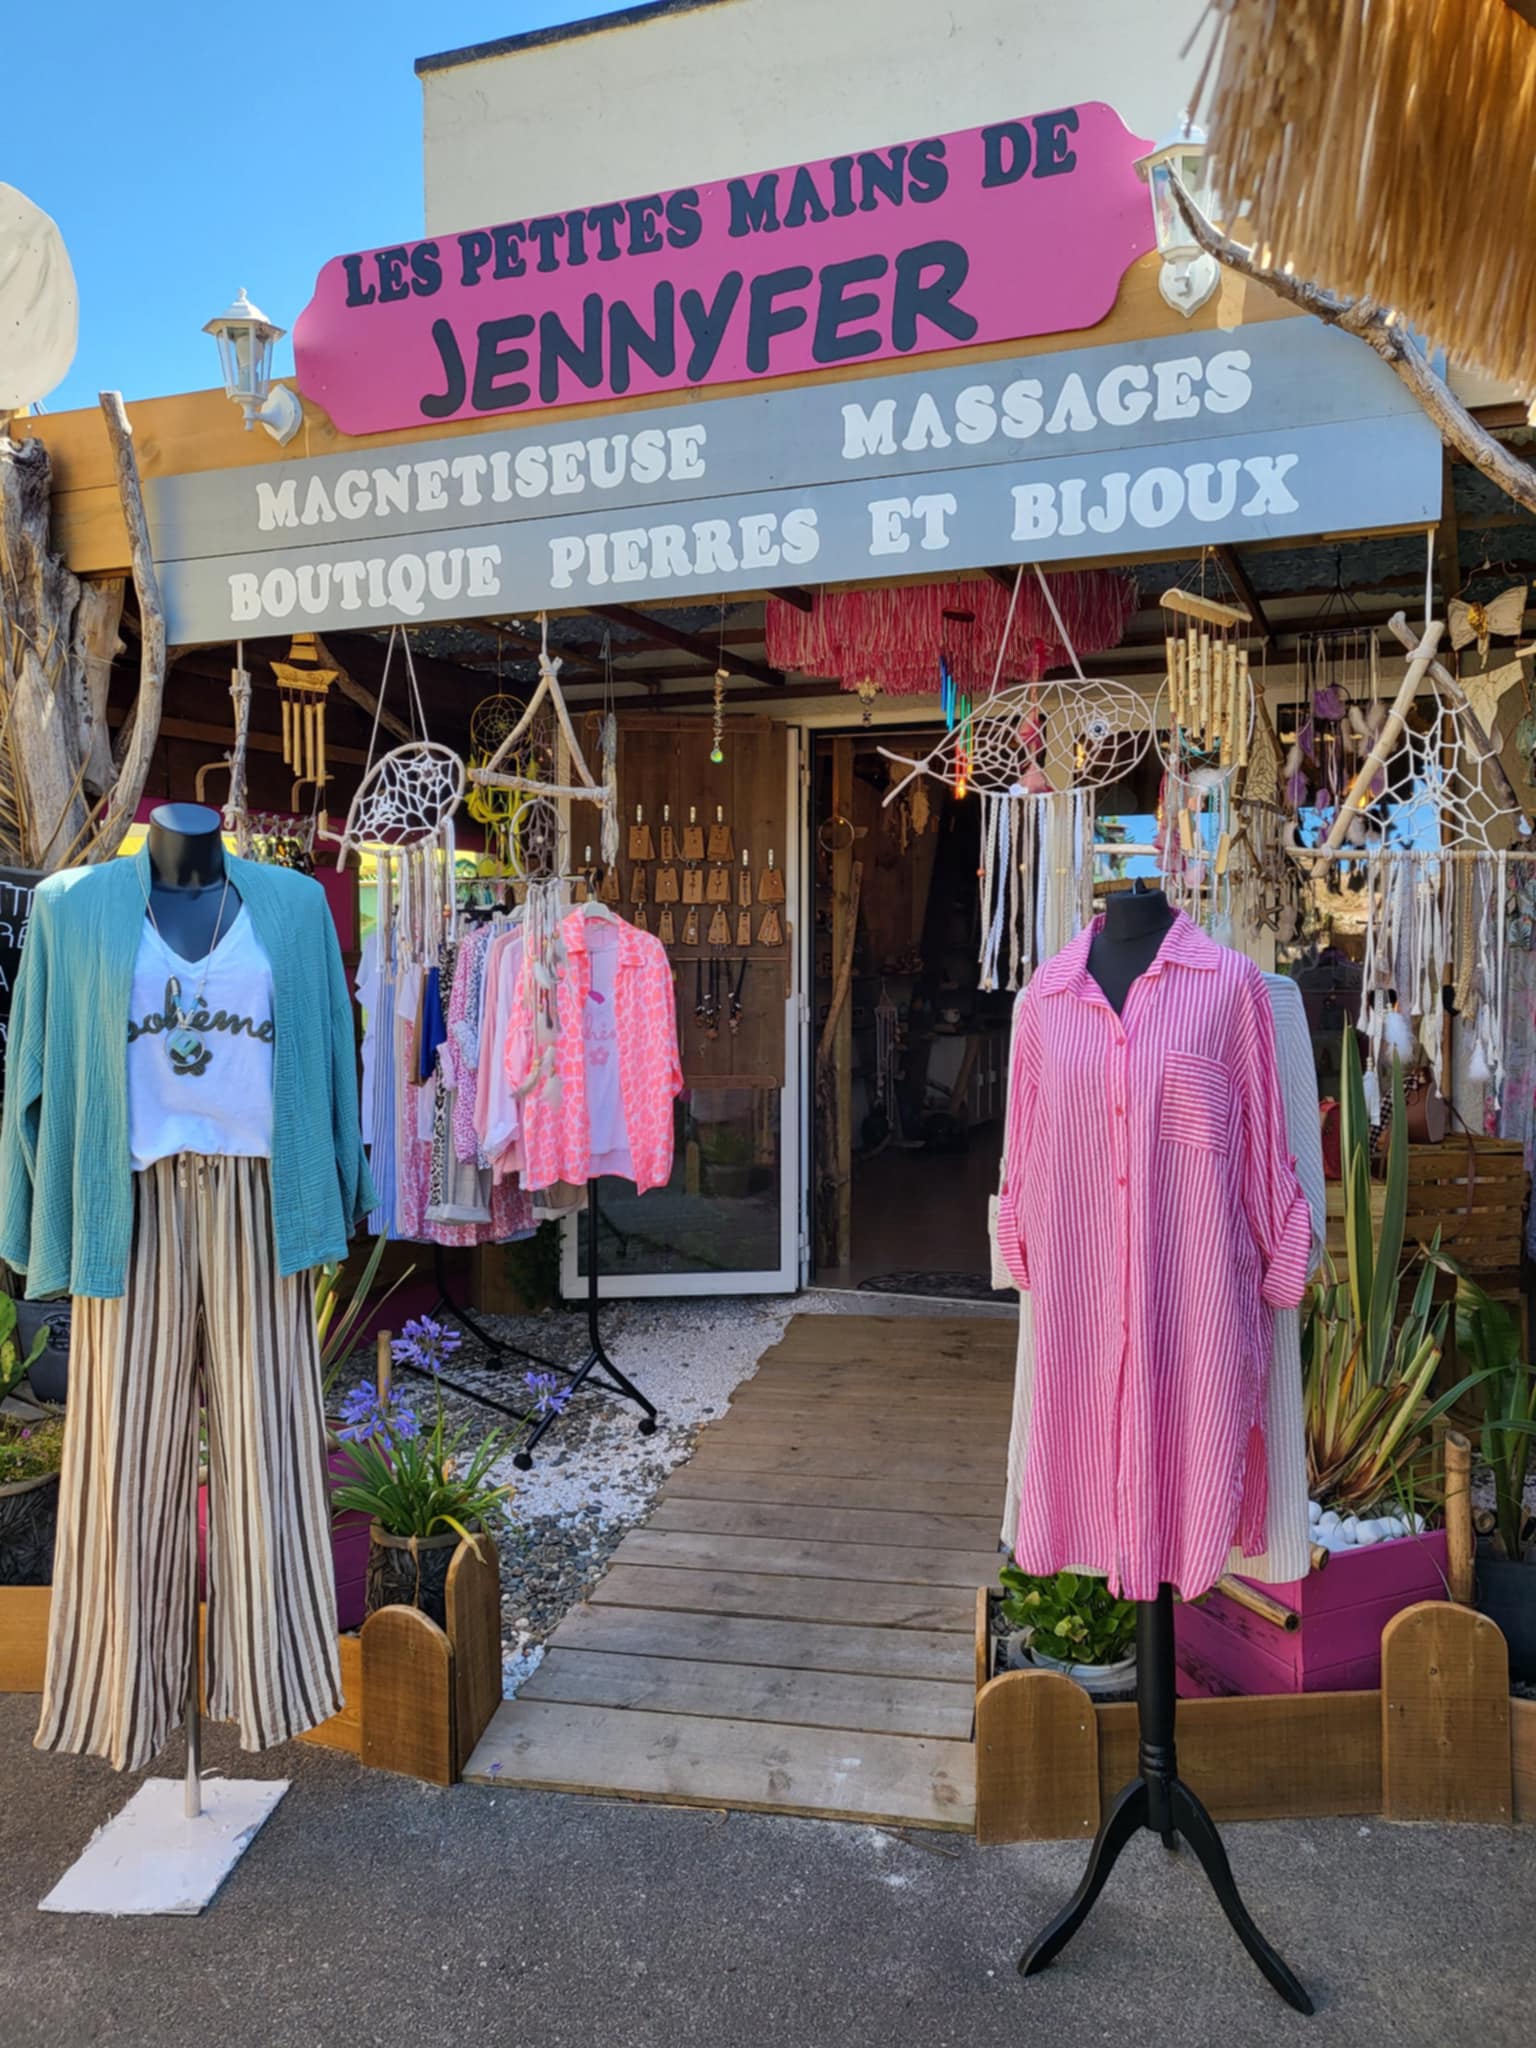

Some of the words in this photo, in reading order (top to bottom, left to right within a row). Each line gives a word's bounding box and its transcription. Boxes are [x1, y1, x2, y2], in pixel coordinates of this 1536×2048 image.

[341, 241, 443, 308] LES
[457, 187, 703, 287] PETITES
[725, 138, 949, 238] MAINS
[980, 107, 1080, 189] DE
[420, 239, 979, 418] JENNYFER
[255, 424, 706, 531] MAGNETISEUSE
[841, 350, 1253, 459] MASSAGES
[228, 544, 502, 622] BOUTIQUE
[548, 508, 820, 589] PIERRES
[868, 494, 957, 555] ET
[1010, 453, 1299, 541] BIJOUX
